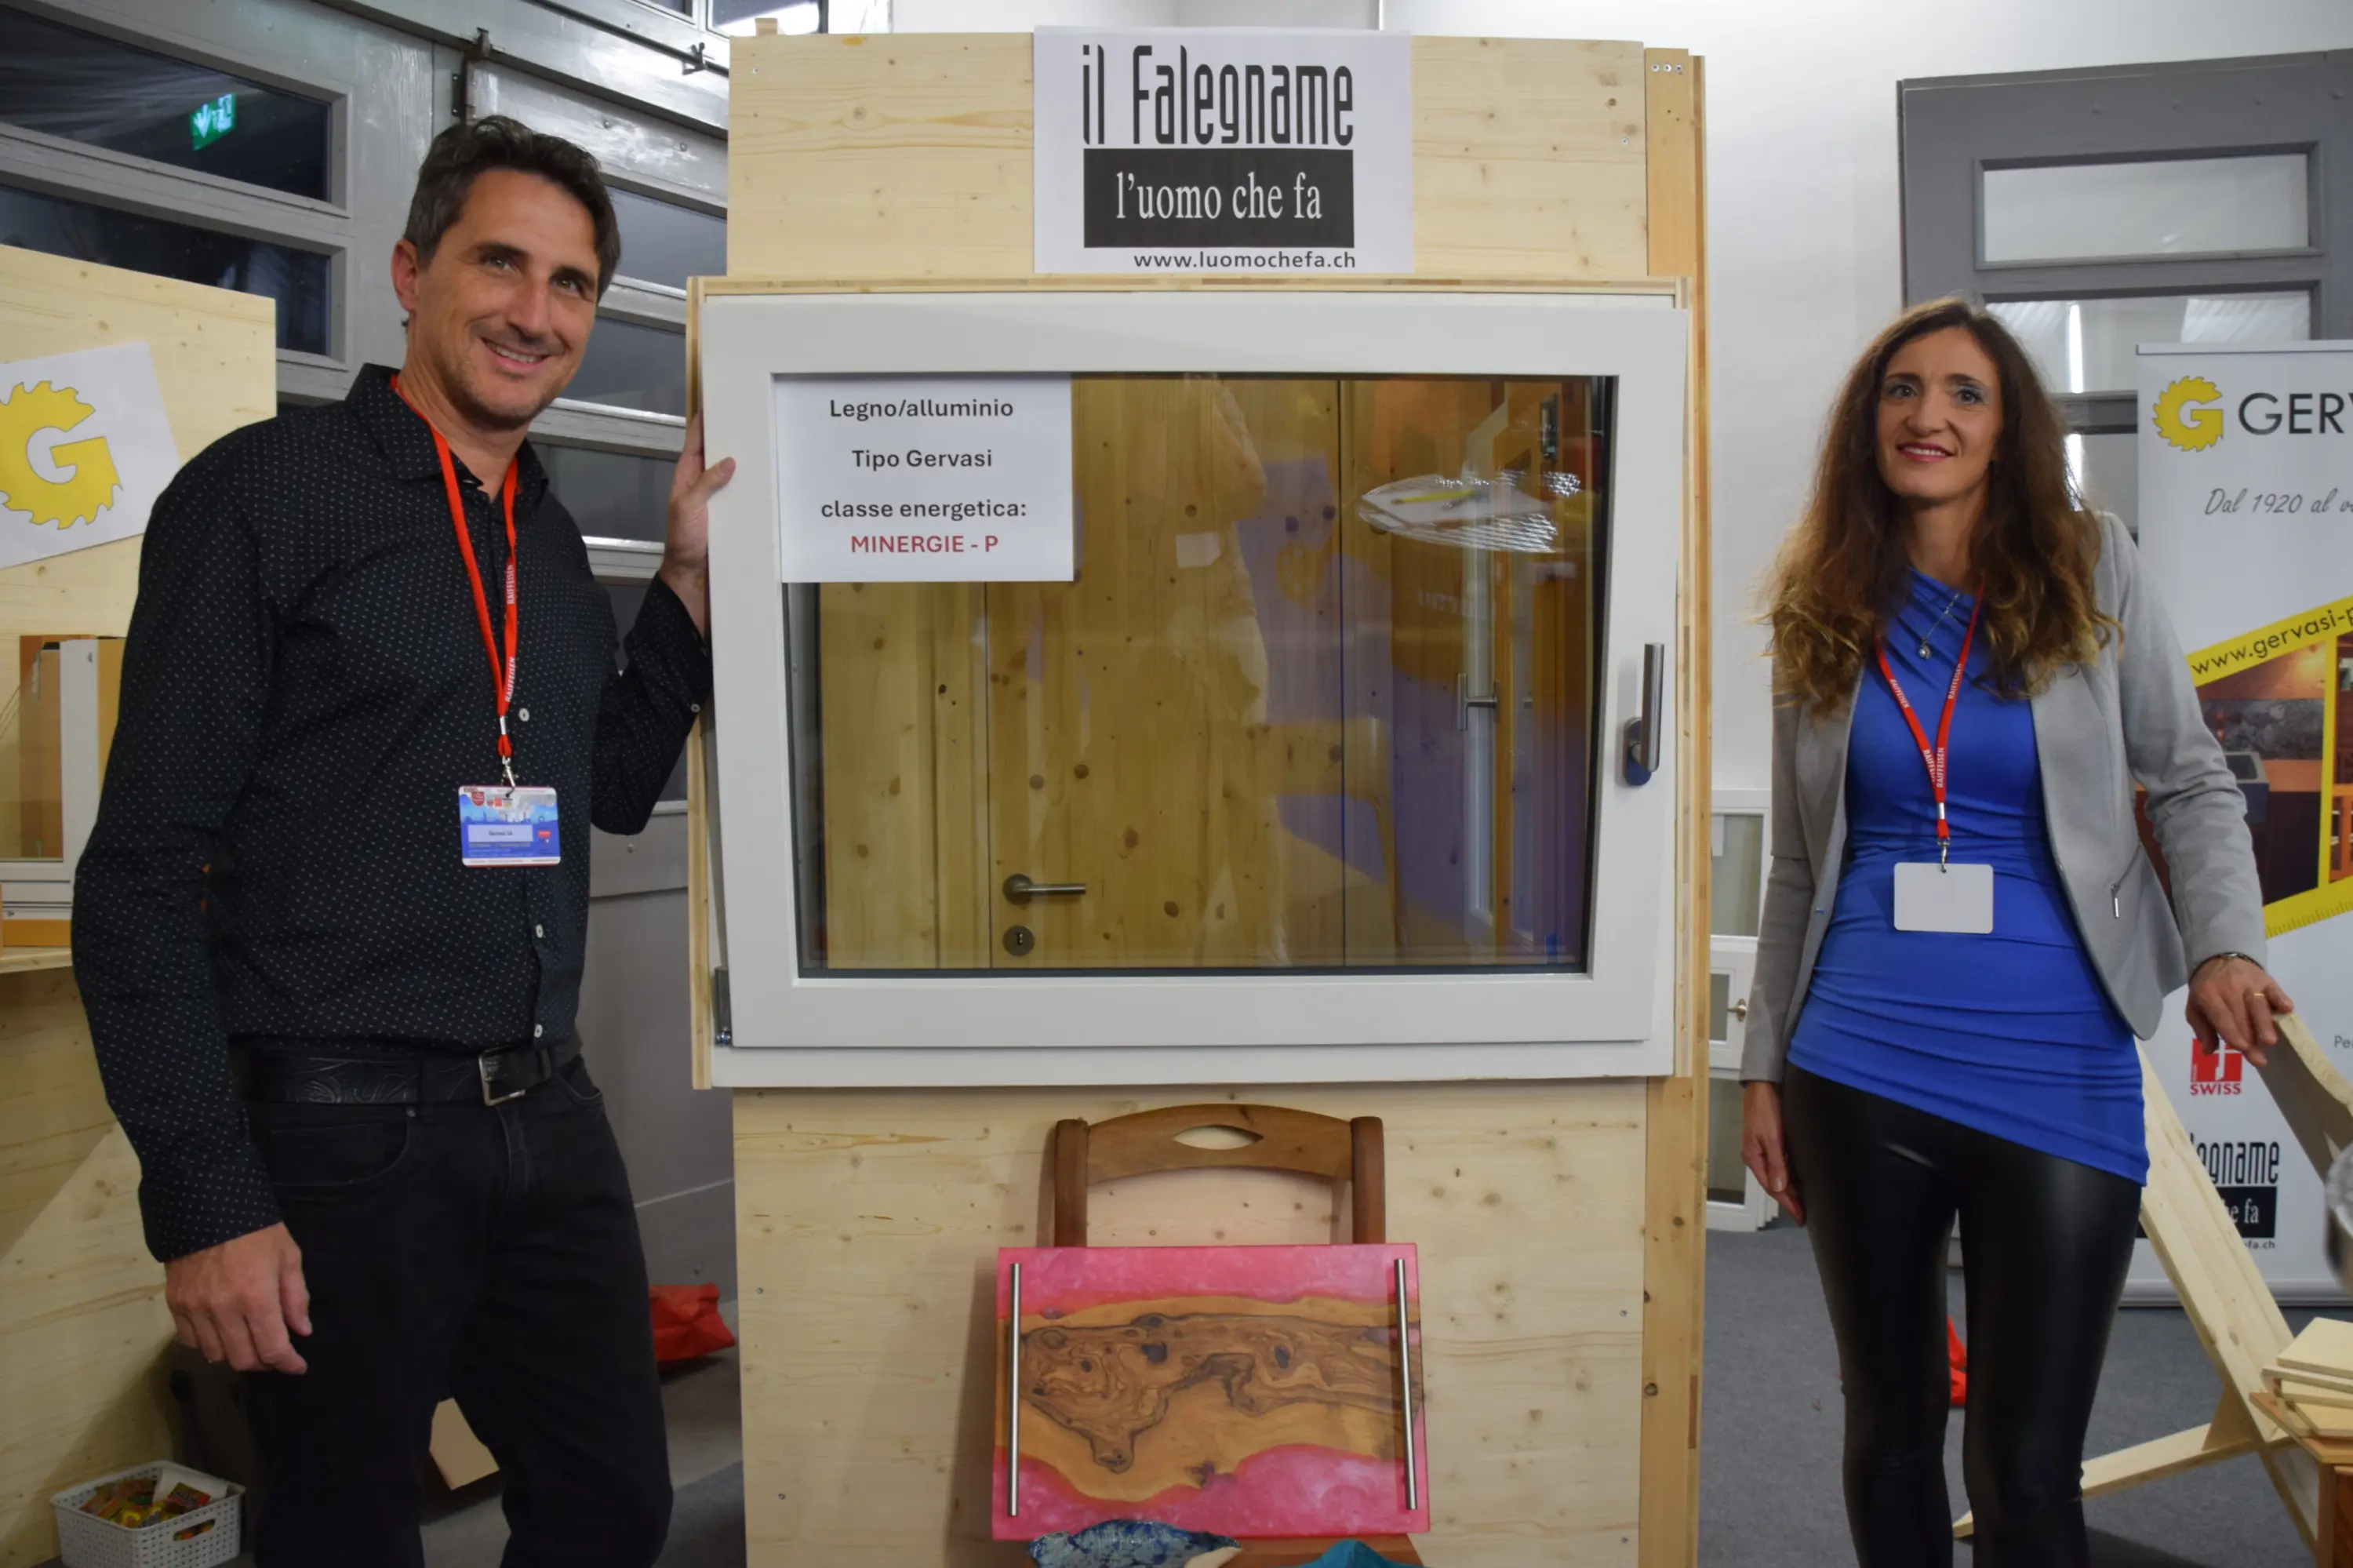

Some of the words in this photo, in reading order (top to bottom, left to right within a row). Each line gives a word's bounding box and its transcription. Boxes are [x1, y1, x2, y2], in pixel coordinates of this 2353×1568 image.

[1082, 44, 1105, 145] il
[1133, 45, 1354, 147] Falegname
[1232, 171, 1284, 219] che
[1293, 171, 1322, 219] fa
[1133, 251, 1356, 268] www.luomochefa.ch
[830, 398, 1013, 422] Legno/alluminio
[2238, 391, 2353, 435] GER
[851, 449, 900, 471] Tipo
[906, 449, 992, 467] Gervasi
[820, 500, 893, 518] classe
[899, 500, 1027, 521] energetica:
[2204, 488, 2248, 515] Dal
[2252, 493, 2303, 514] 1920
[2310, 487, 2339, 514] al
[850, 535, 965, 553] MINERGIE
[984, 535, 998, 553] P
[504, 656, 517, 703] RAIFFEISEN
[2334, 1035, 2353, 1049] Pe
[2190, 1082, 2242, 1096] SWISS
[2243, 1198, 2260, 1224] fa
[2244, 1239, 2276, 1250] fa.ch
